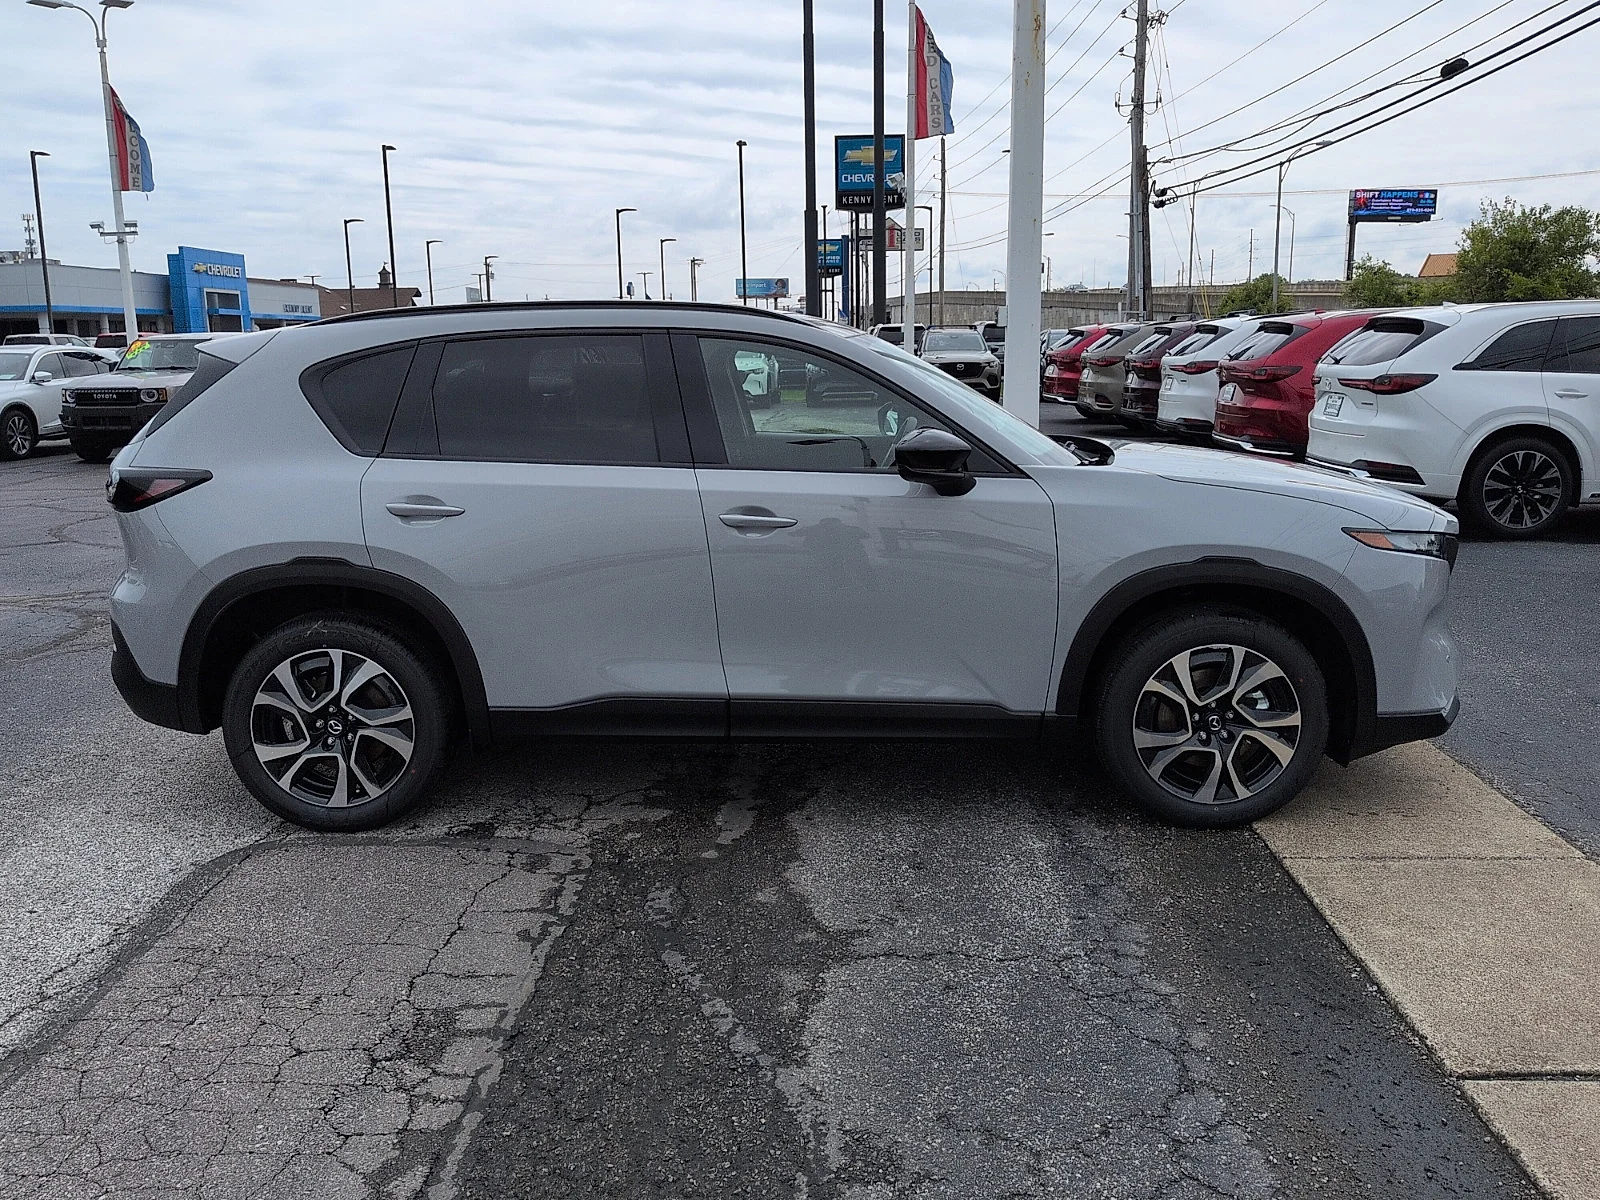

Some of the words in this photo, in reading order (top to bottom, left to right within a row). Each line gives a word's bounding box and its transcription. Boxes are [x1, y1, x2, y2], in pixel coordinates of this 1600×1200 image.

[929, 77, 942, 129] CARS
[842, 195, 872, 205] KENNY
[1355, 191, 1380, 199] SHIFT
[1380, 191, 1418, 199] HAPPENS
[207, 263, 242, 279] CHEVROLET
